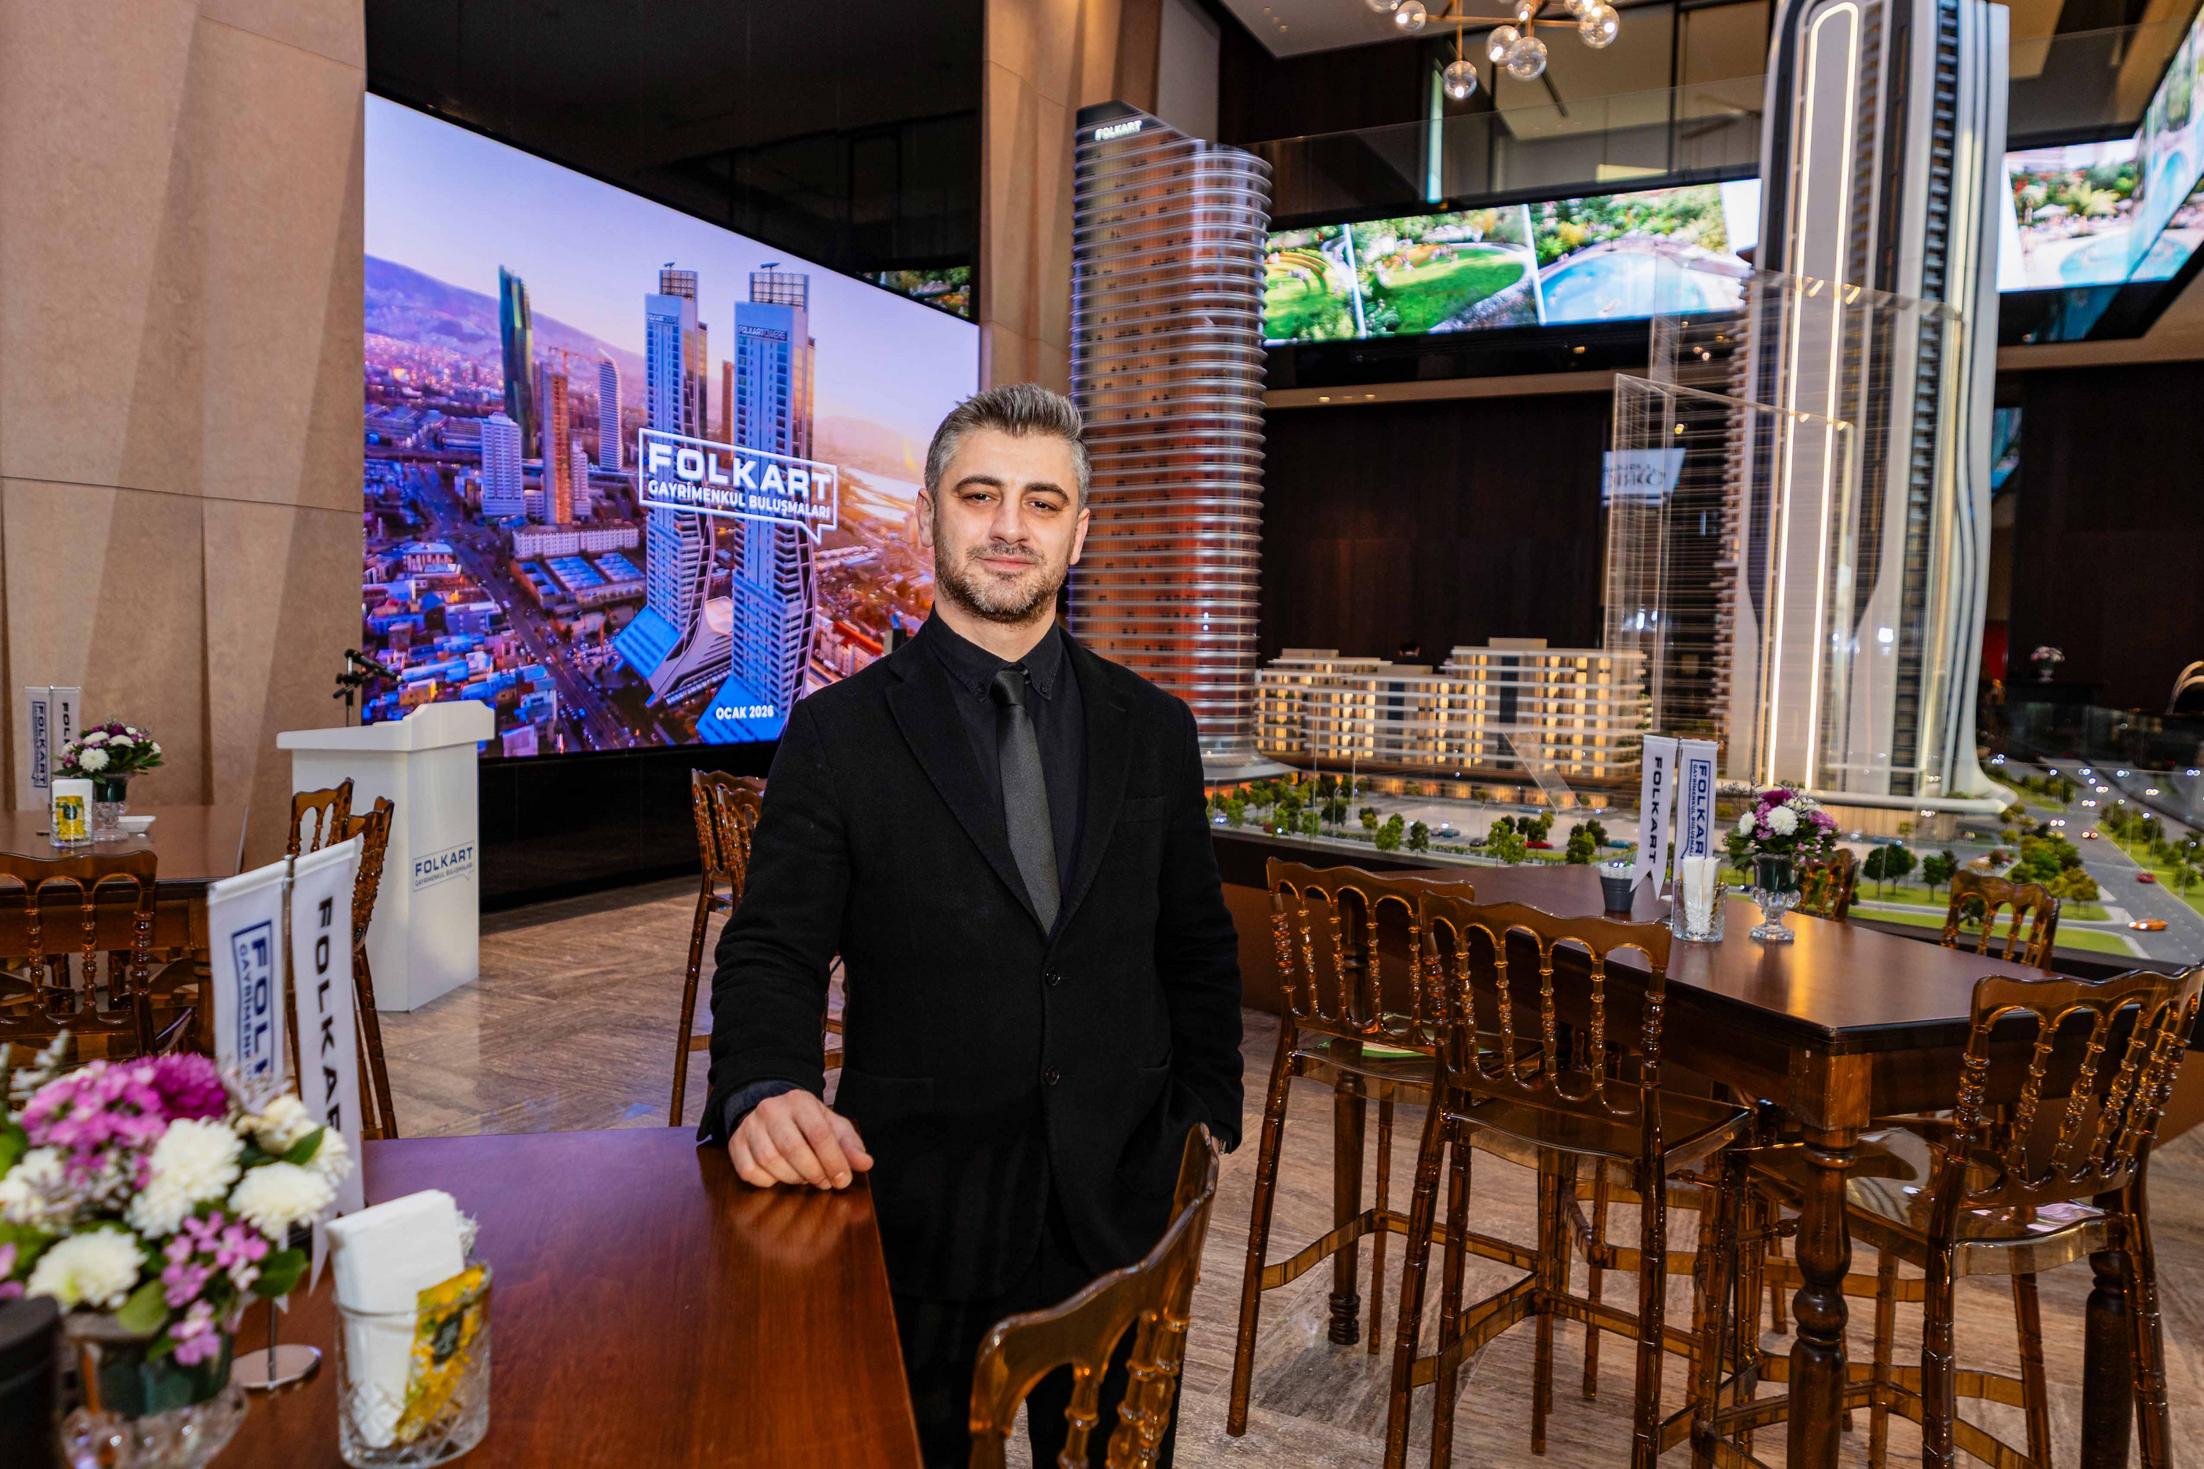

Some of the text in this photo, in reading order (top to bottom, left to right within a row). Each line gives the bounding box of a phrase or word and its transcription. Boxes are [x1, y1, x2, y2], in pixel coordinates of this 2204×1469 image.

[1094, 119, 1143, 141] FOLKART
[648, 442, 832, 500] FOLKART
[648, 479, 831, 519] GAYRİMENKUL BULUŞMALARI
[61, 702, 70, 745] FOL
[715, 704, 775, 721] OCAK 2026
[1648, 756, 1663, 865] FOLKART
[1695, 764, 1707, 855] FOLKAR
[415, 846, 473, 877] FOLKART
[239, 943, 253, 1070] GAYRİMENK
[314, 895, 341, 1132] FOLKAR
